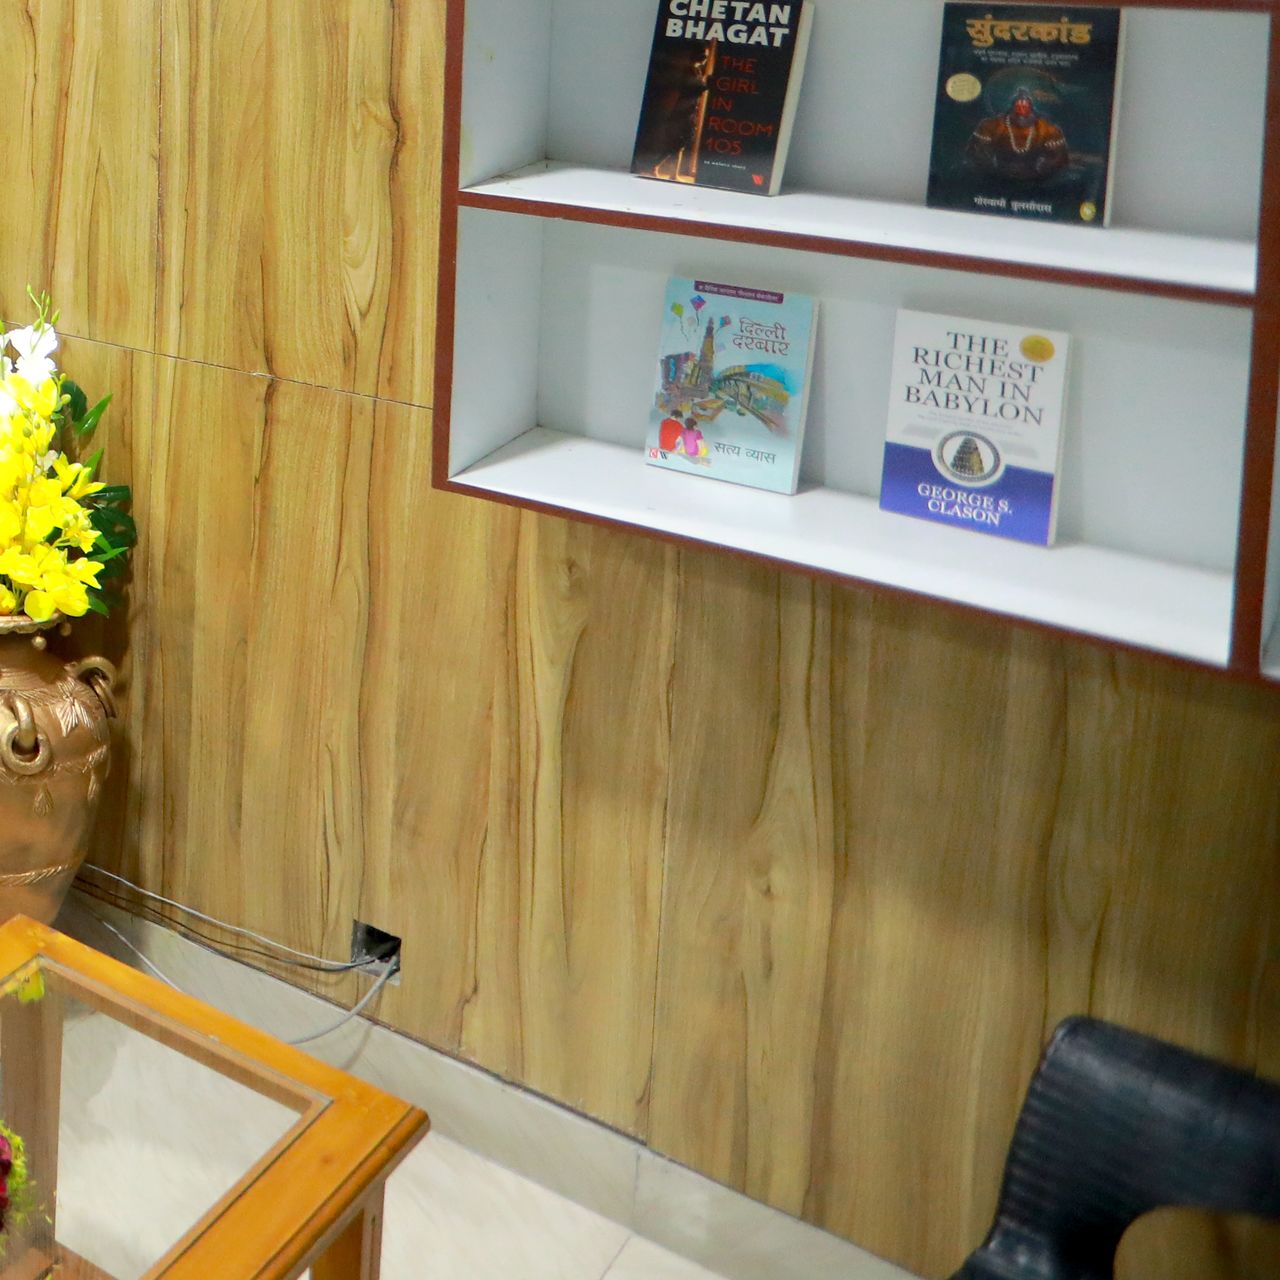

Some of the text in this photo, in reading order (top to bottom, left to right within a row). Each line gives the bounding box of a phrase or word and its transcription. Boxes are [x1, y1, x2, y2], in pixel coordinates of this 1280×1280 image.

[665, 19, 790, 47] BHAGAT
[722, 55, 758, 73] THE
[715, 76, 759, 94] GIRL
[713, 97, 733, 112] IN
[708, 116, 773, 136] ROOM
[706, 139, 743, 156] 105
[739, 317, 786, 340] दिल्ली
[732, 333, 790, 356] दरबार
[947, 331, 1008, 357] THE
[912, 347, 1044, 383] RICHEST
[918, 368, 1031, 402] MAN IN
[904, 385, 1044, 426] BABYLON
[713, 441, 777, 464] सत्य व्यास
[918, 483, 1013, 515] GEORGE S.
[928, 499, 1000, 527] CLASON
